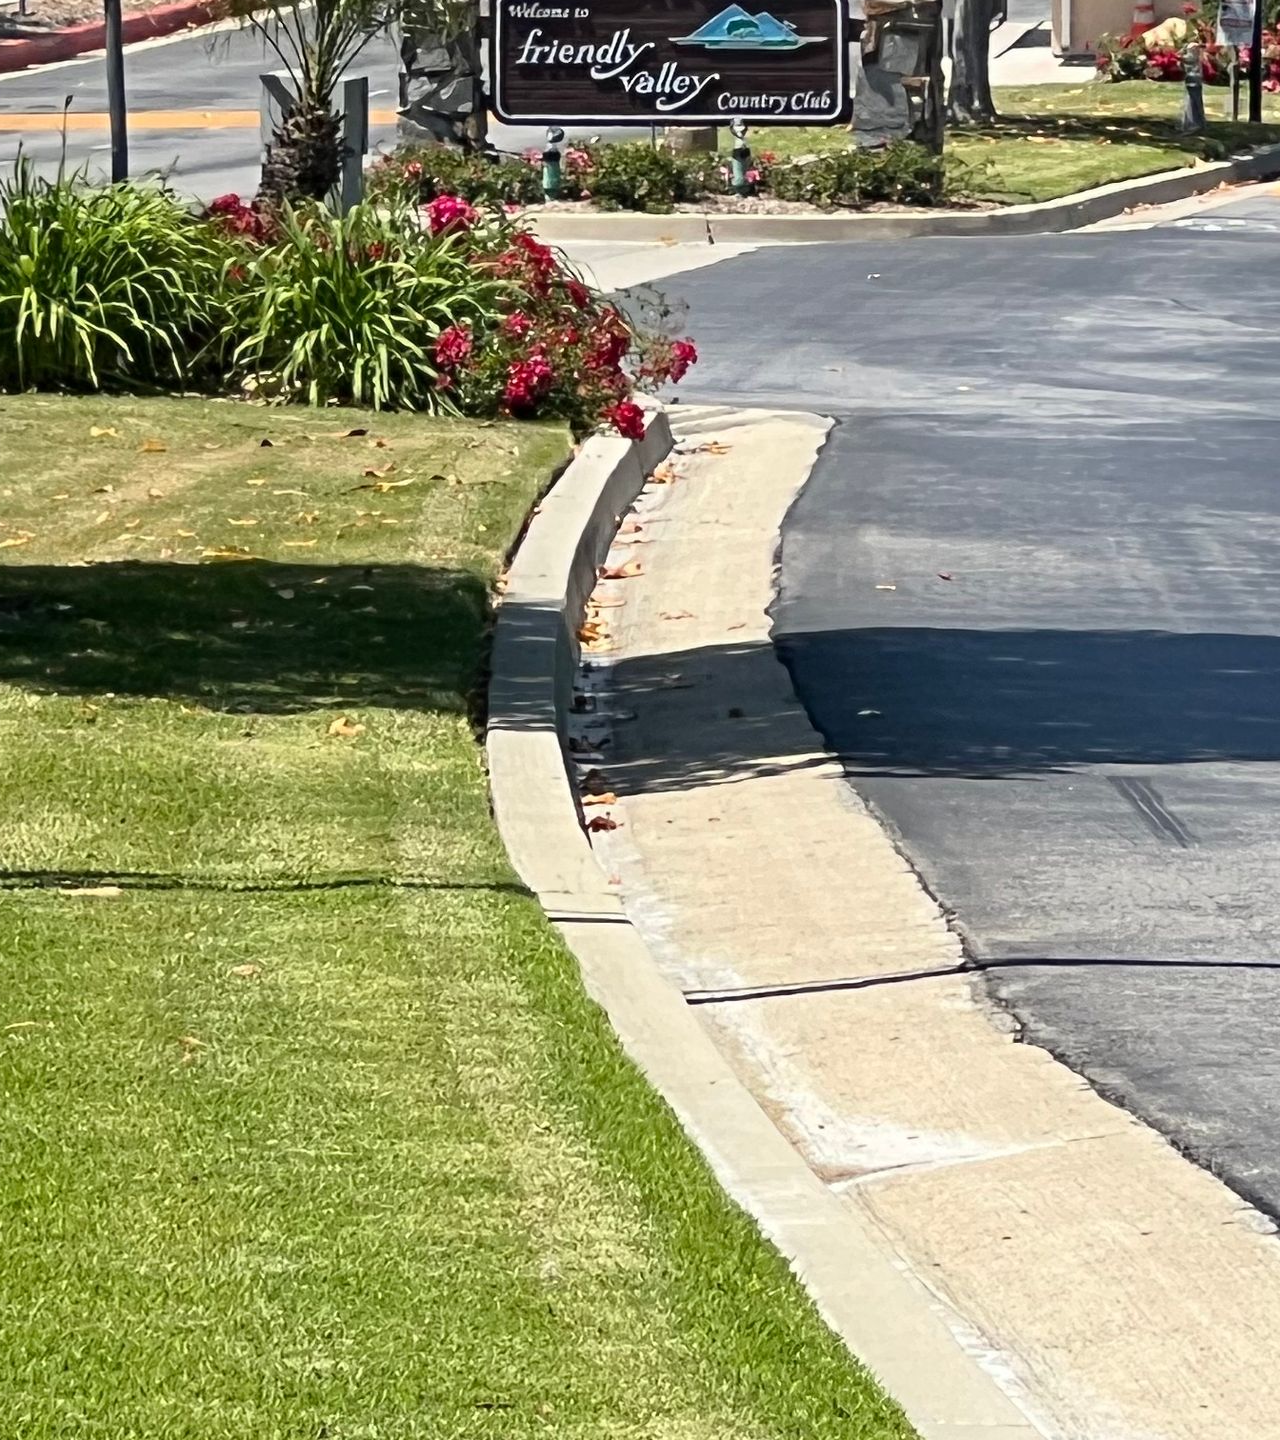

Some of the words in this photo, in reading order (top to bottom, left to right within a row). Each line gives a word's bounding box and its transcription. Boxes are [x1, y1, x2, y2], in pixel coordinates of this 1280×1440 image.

[508, 2, 570, 18] Welcome
[574, 7, 589, 18] to
[515, 27, 655, 80] friendly
[618, 61, 720, 111] valley
[717, 92, 788, 114] Country
[790, 90, 831, 109] Club
